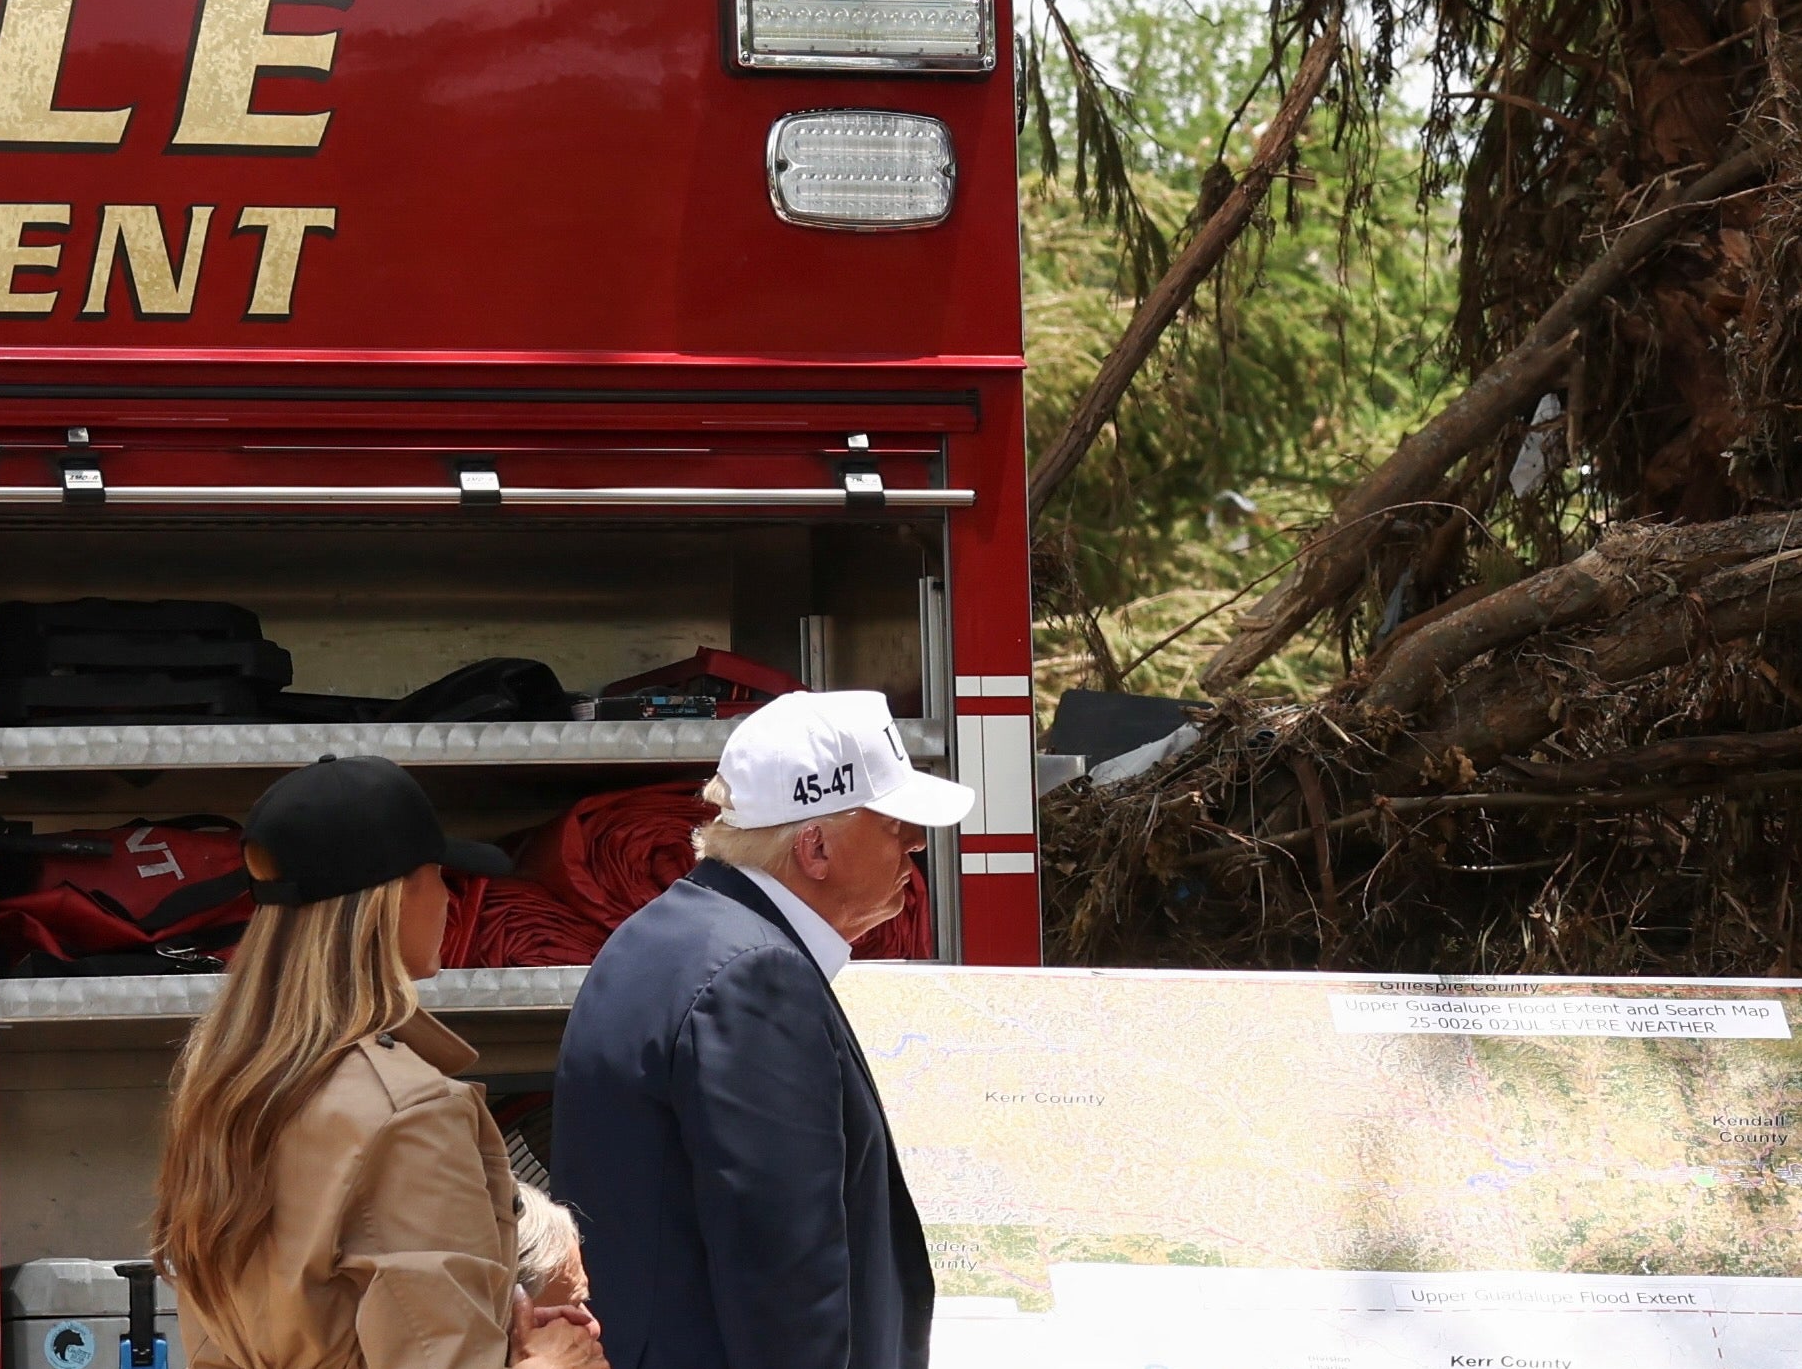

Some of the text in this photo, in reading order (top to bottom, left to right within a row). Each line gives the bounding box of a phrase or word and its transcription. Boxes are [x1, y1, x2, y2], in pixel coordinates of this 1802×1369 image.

[793, 763, 854, 805] 45-47
[1345, 999, 1769, 1019] Upper Guadalupe Flood Extent and Search Map
[1409, 1016, 1483, 1030] 25-0026
[1550, 1019, 1620, 1032] SEVERE
[1626, 1021, 1717, 1033] WEATHER
[985, 1091, 1106, 1107] Kerr County
[1712, 1115, 1786, 1128] Kendall
[1719, 1131, 1789, 1146] County
[928, 1241, 979, 1251] ndera
[934, 1259, 978, 1272] unty
[1411, 1289, 1696, 1306] Upper Guadalupe Flood Extent
[1450, 1355, 1494, 1368] Kerr
